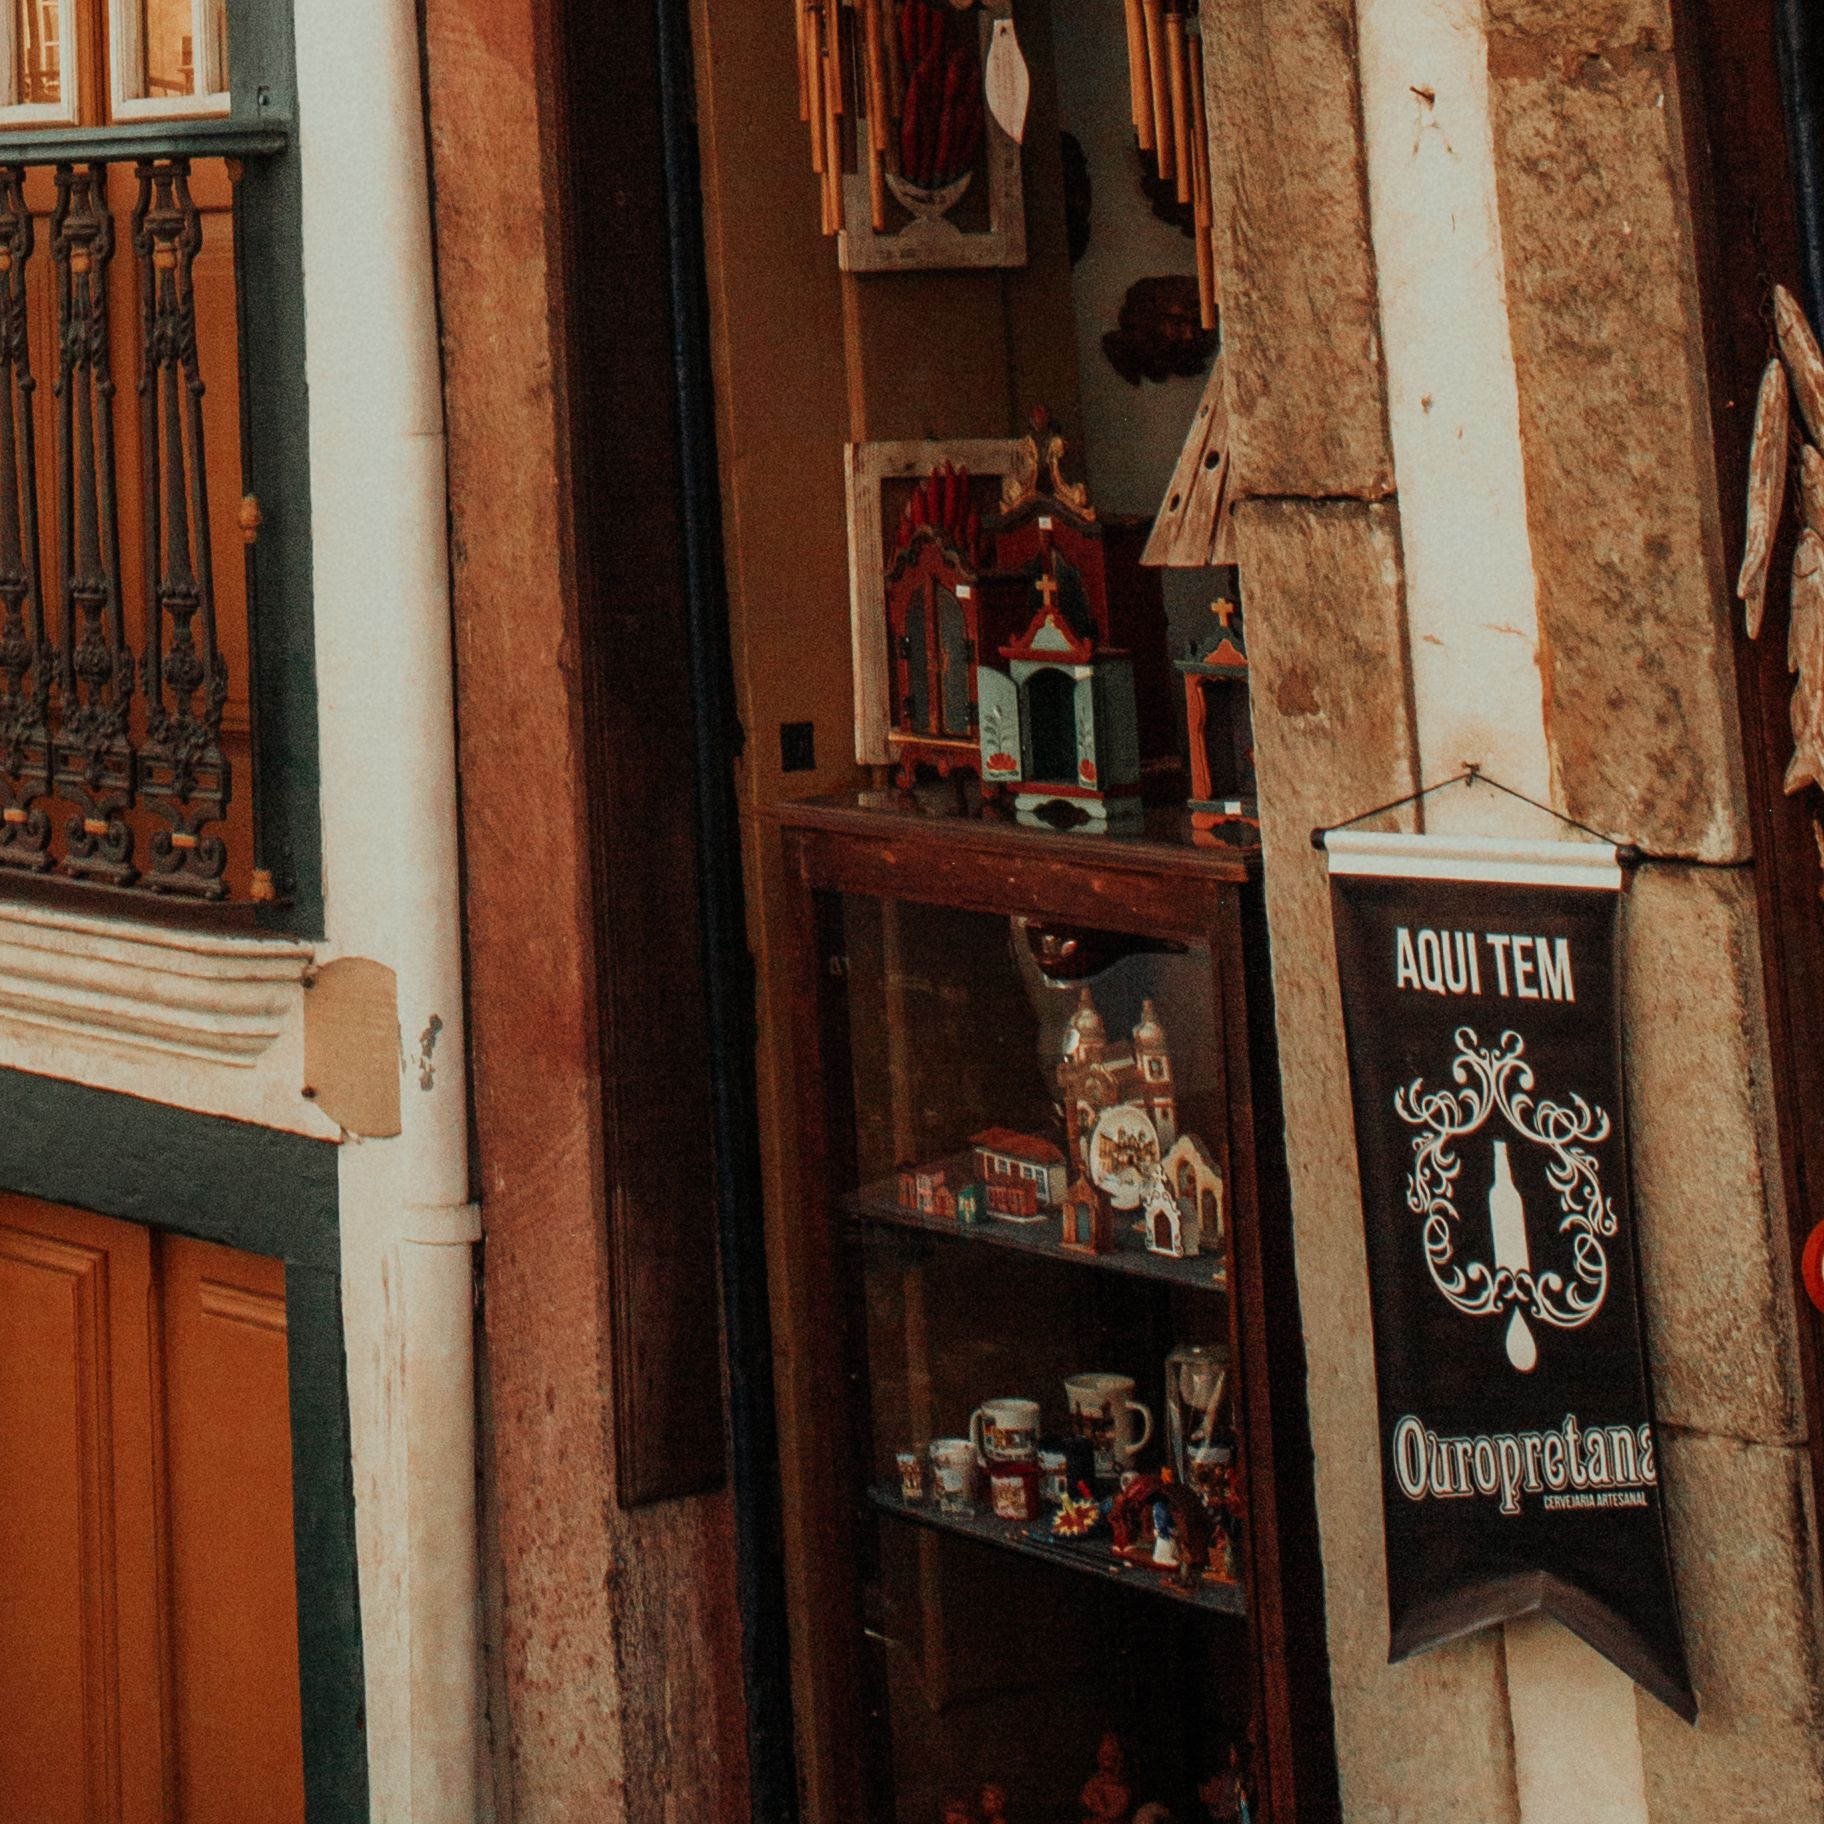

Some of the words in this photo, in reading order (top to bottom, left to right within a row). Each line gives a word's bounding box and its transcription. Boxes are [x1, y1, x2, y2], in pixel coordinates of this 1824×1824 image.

[1396, 926, 1482, 997] AQUI
[1486, 932, 1576, 1003] TEM
[1393, 1413, 1657, 1515] Ouropretana
[1596, 1491, 1648, 1508] ARTESANAL
